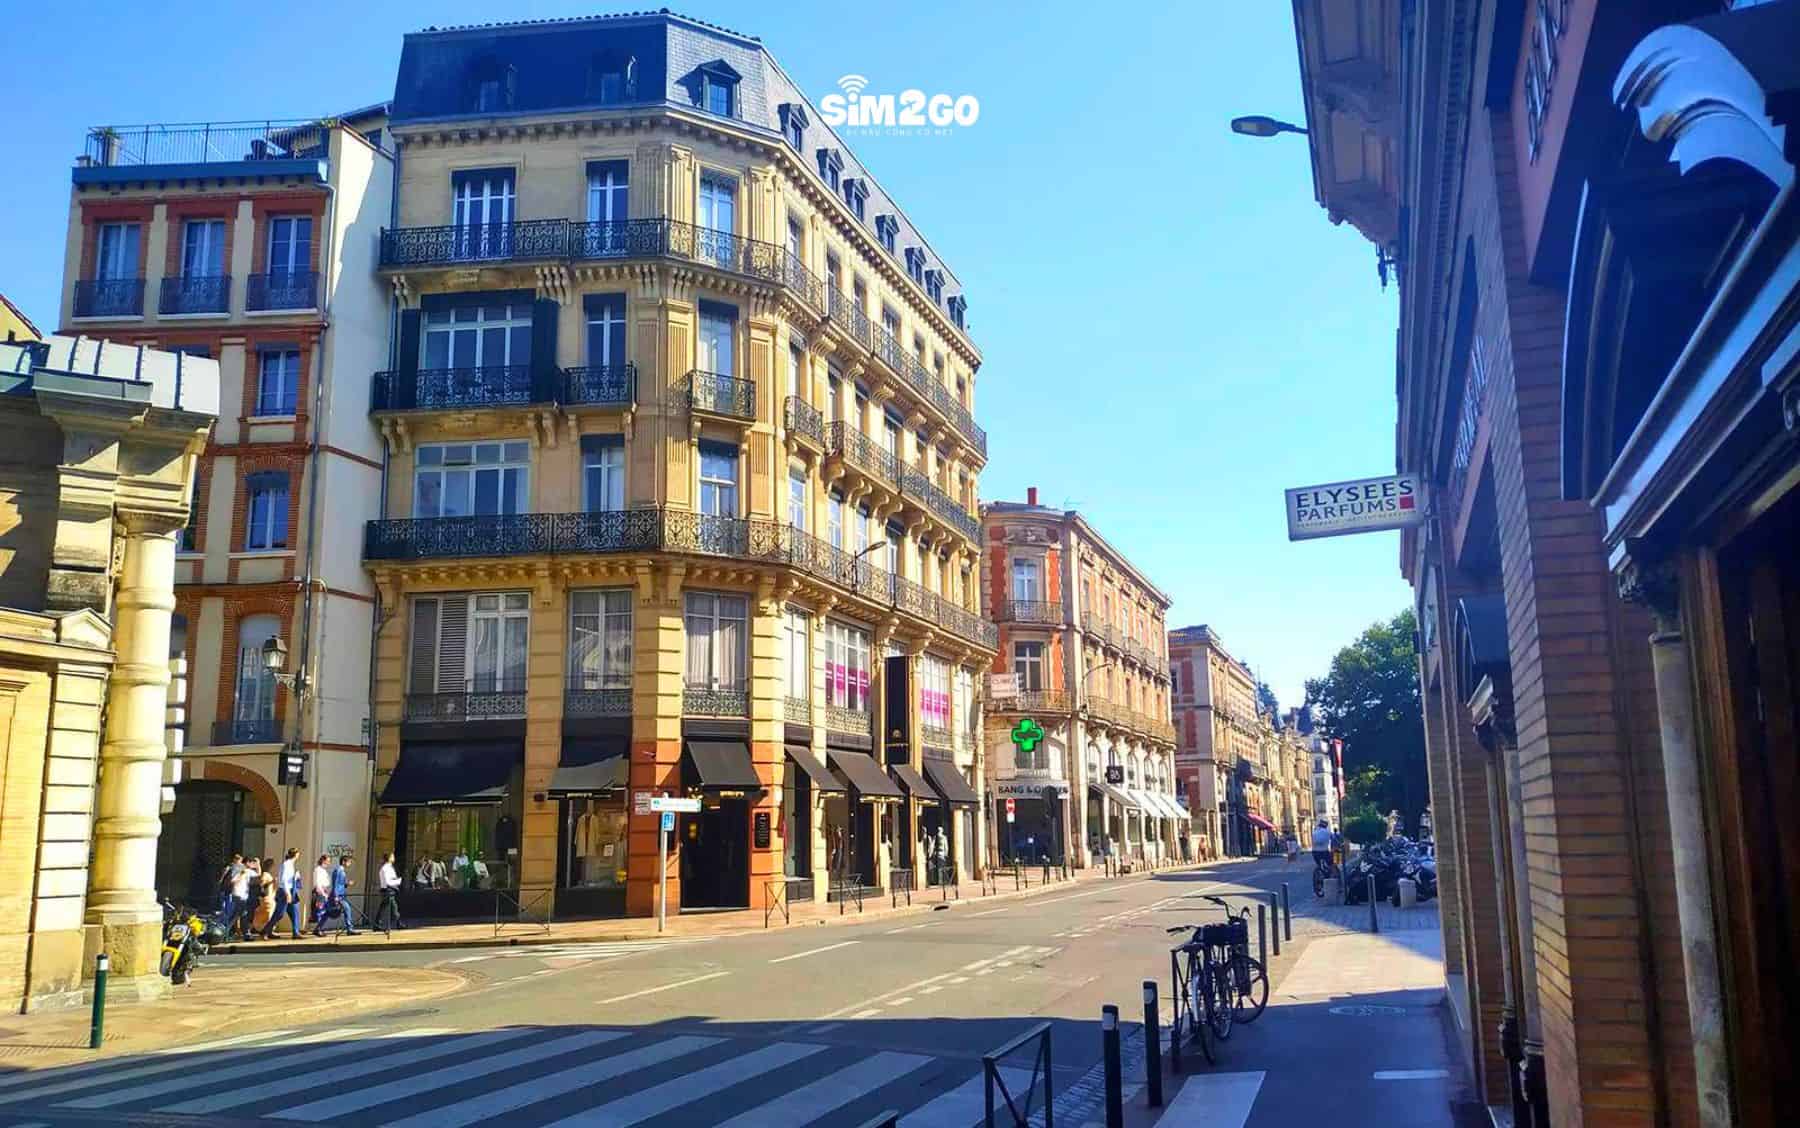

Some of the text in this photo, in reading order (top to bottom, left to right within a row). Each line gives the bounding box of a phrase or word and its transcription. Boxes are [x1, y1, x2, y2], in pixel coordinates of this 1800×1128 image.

[1296, 479, 1414, 508] ELYSEES
[1296, 498, 1397, 522] PARFUMS
[998, 784, 1025, 794] BANG
